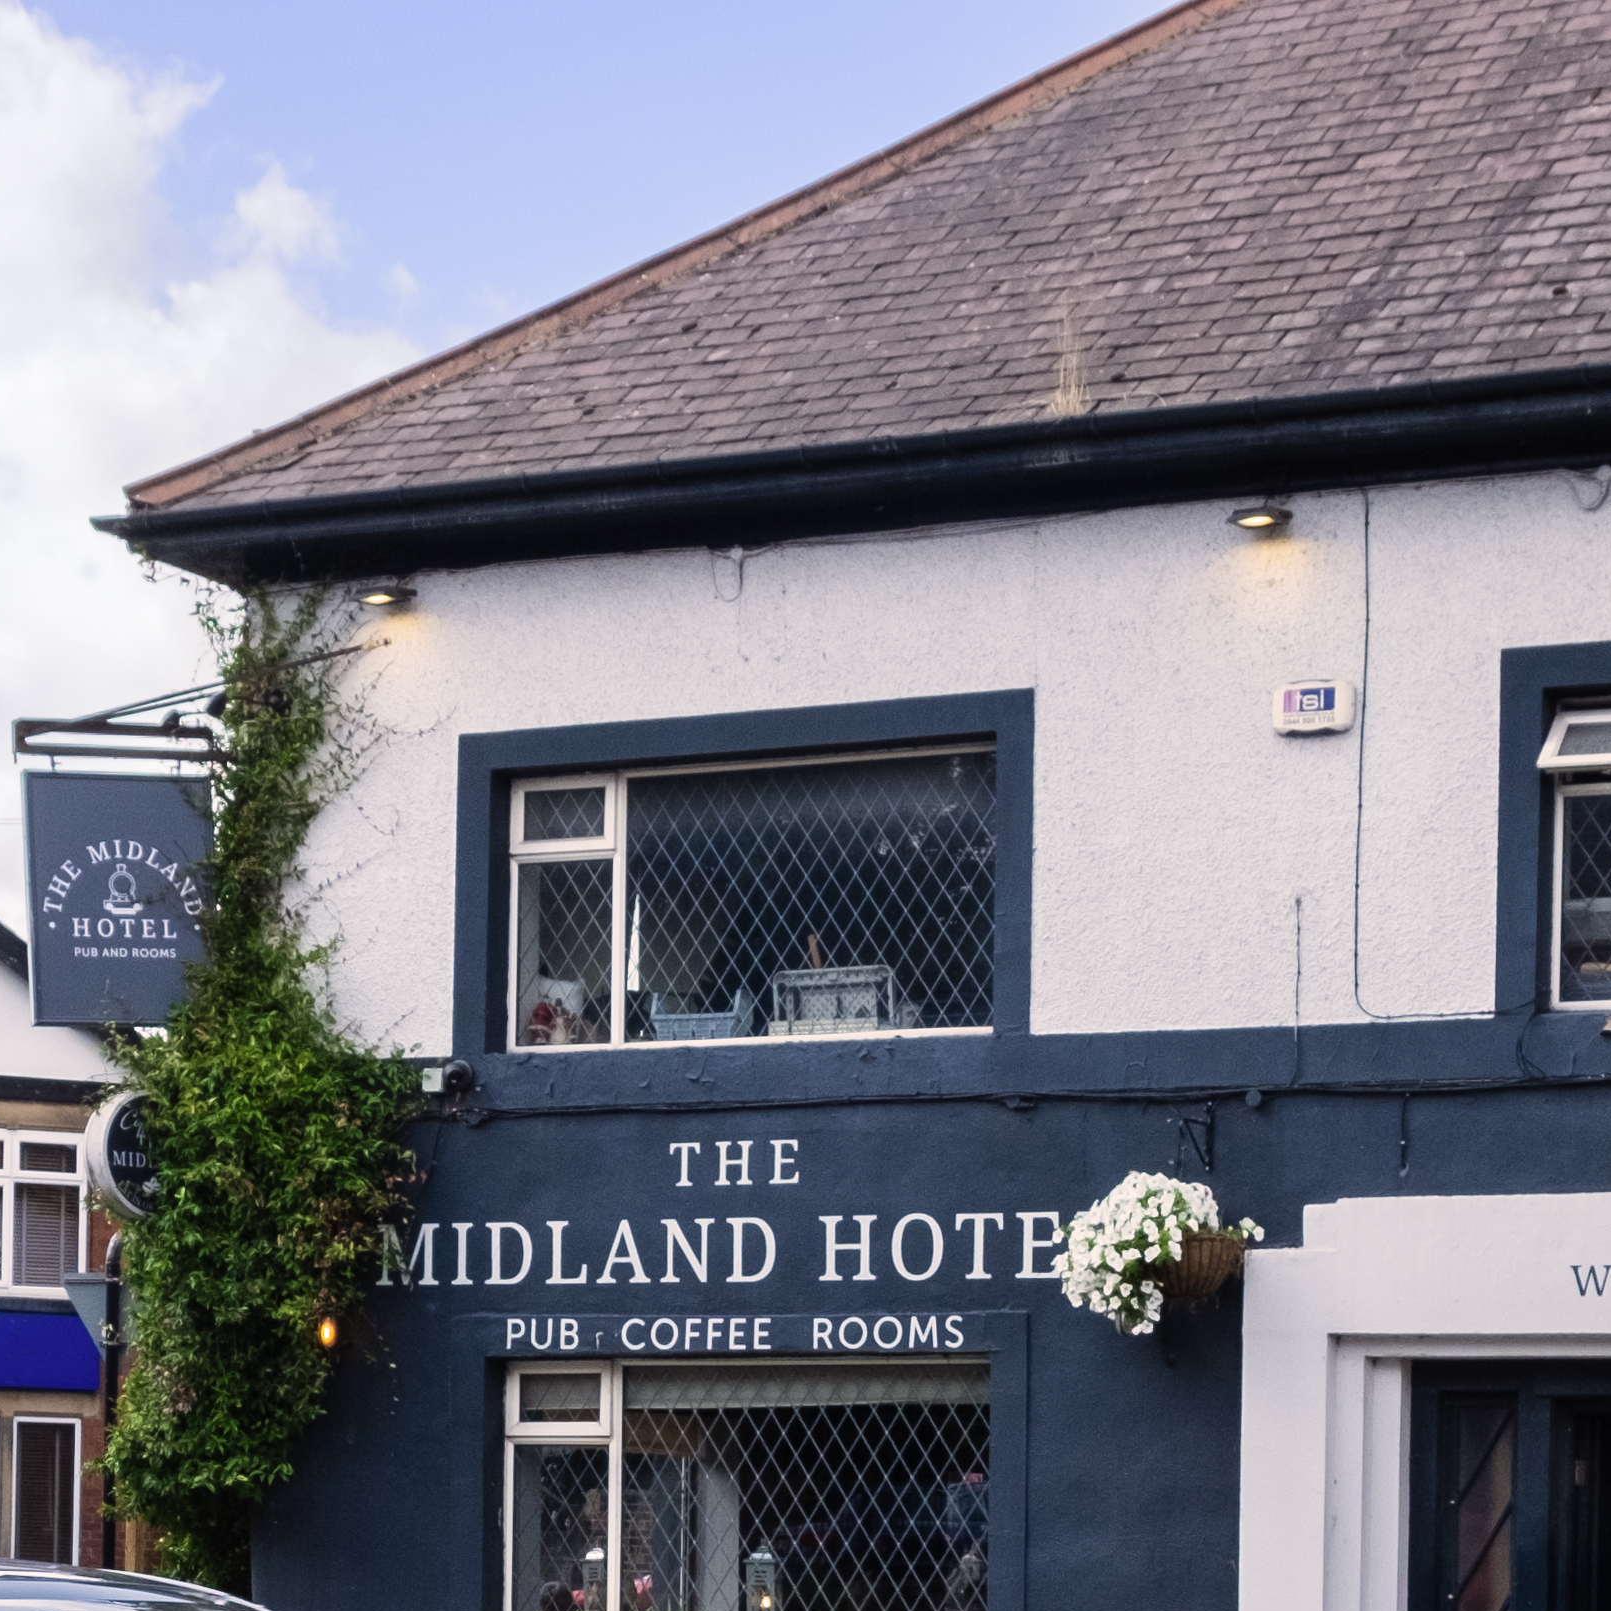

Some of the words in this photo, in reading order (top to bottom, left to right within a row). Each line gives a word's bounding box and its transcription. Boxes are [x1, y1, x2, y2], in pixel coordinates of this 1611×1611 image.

[43, 859, 82, 912] THE
[85, 839, 203, 915] MIDLAND
[71, 917, 177, 938] HOTEL
[74, 947, 98, 957] PUB
[102, 947, 128, 958] AND
[132, 948, 177, 958] ROOMS
[671, 1141, 800, 1187] THE
[375, 1218, 776, 1286] MIDLAND
[820, 1213, 1061, 1282] HOTE
[508, 1319, 579, 1350] PUB
[623, 1319, 772, 1351] COFFEE
[814, 1316, 964, 1350] ROOMS
